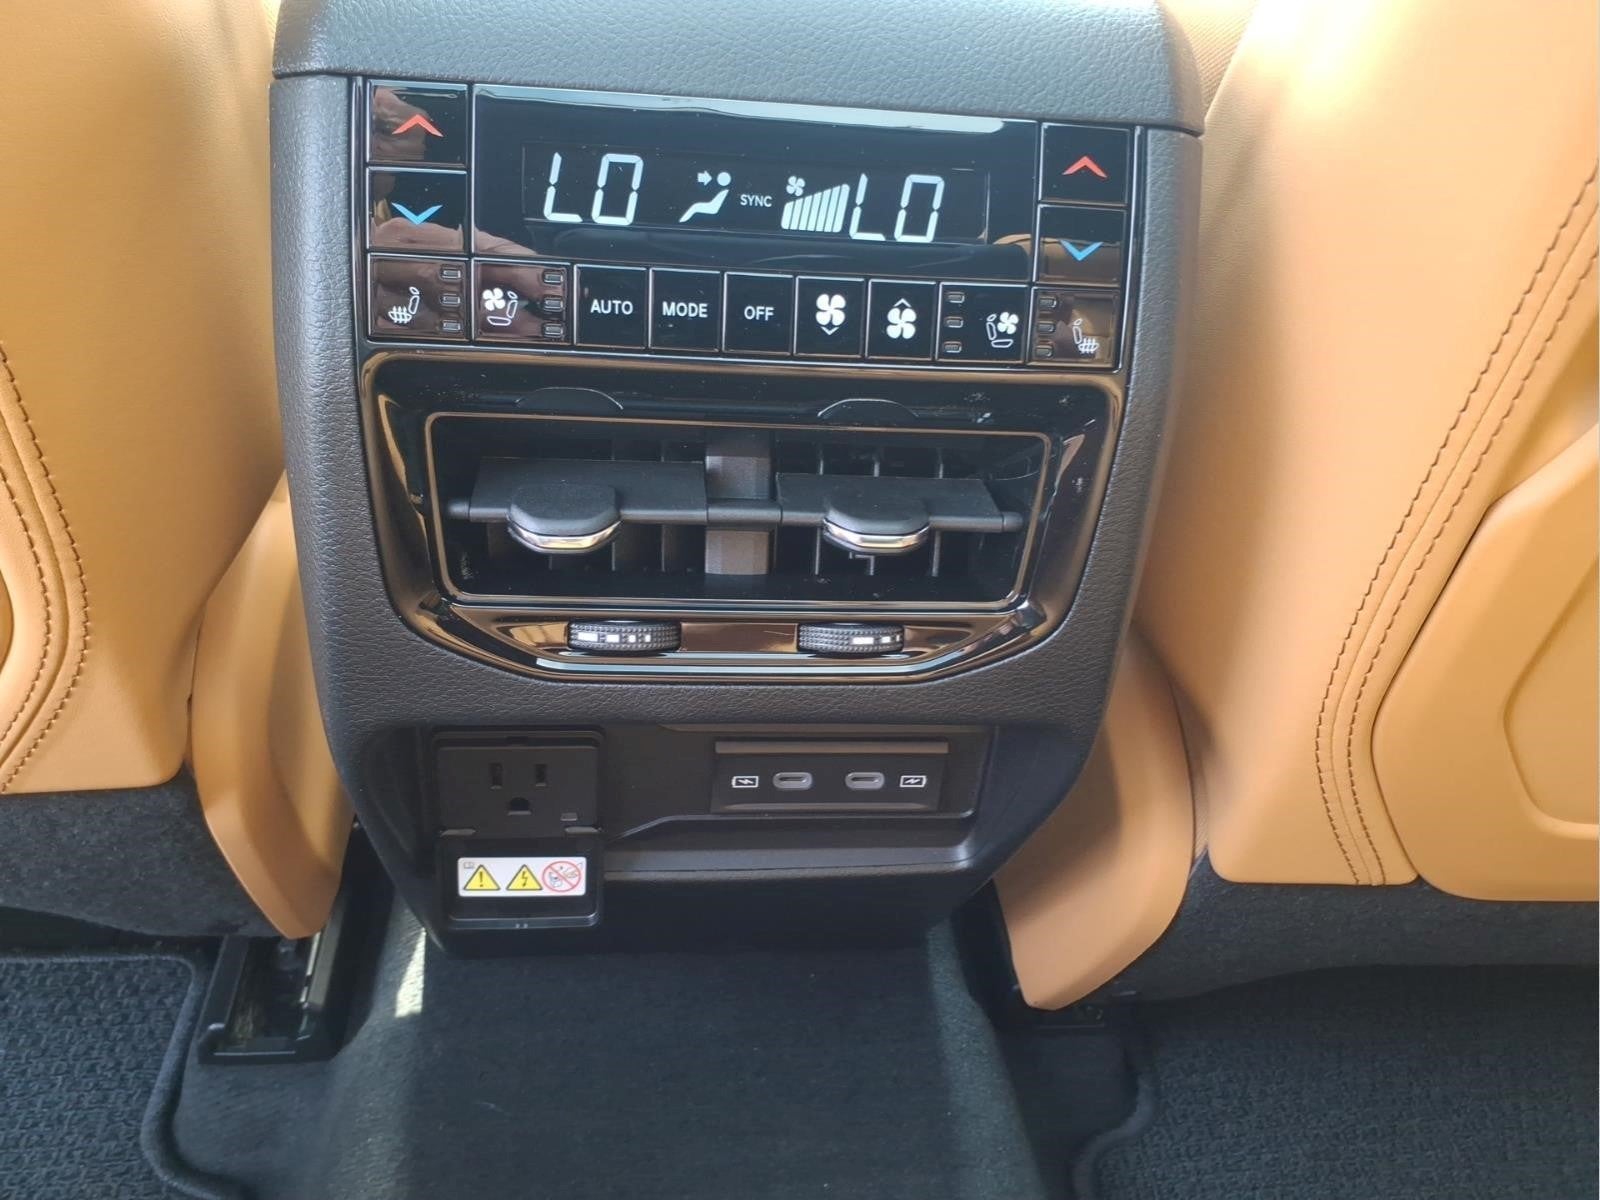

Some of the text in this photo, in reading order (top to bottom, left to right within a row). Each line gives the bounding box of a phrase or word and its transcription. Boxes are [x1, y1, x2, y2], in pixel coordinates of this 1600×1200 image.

[740, 194, 773, 208] SYNC
[590, 299, 634, 316] AUTO
[662, 301, 709, 319] MODE
[743, 305, 774, 321] OFF
